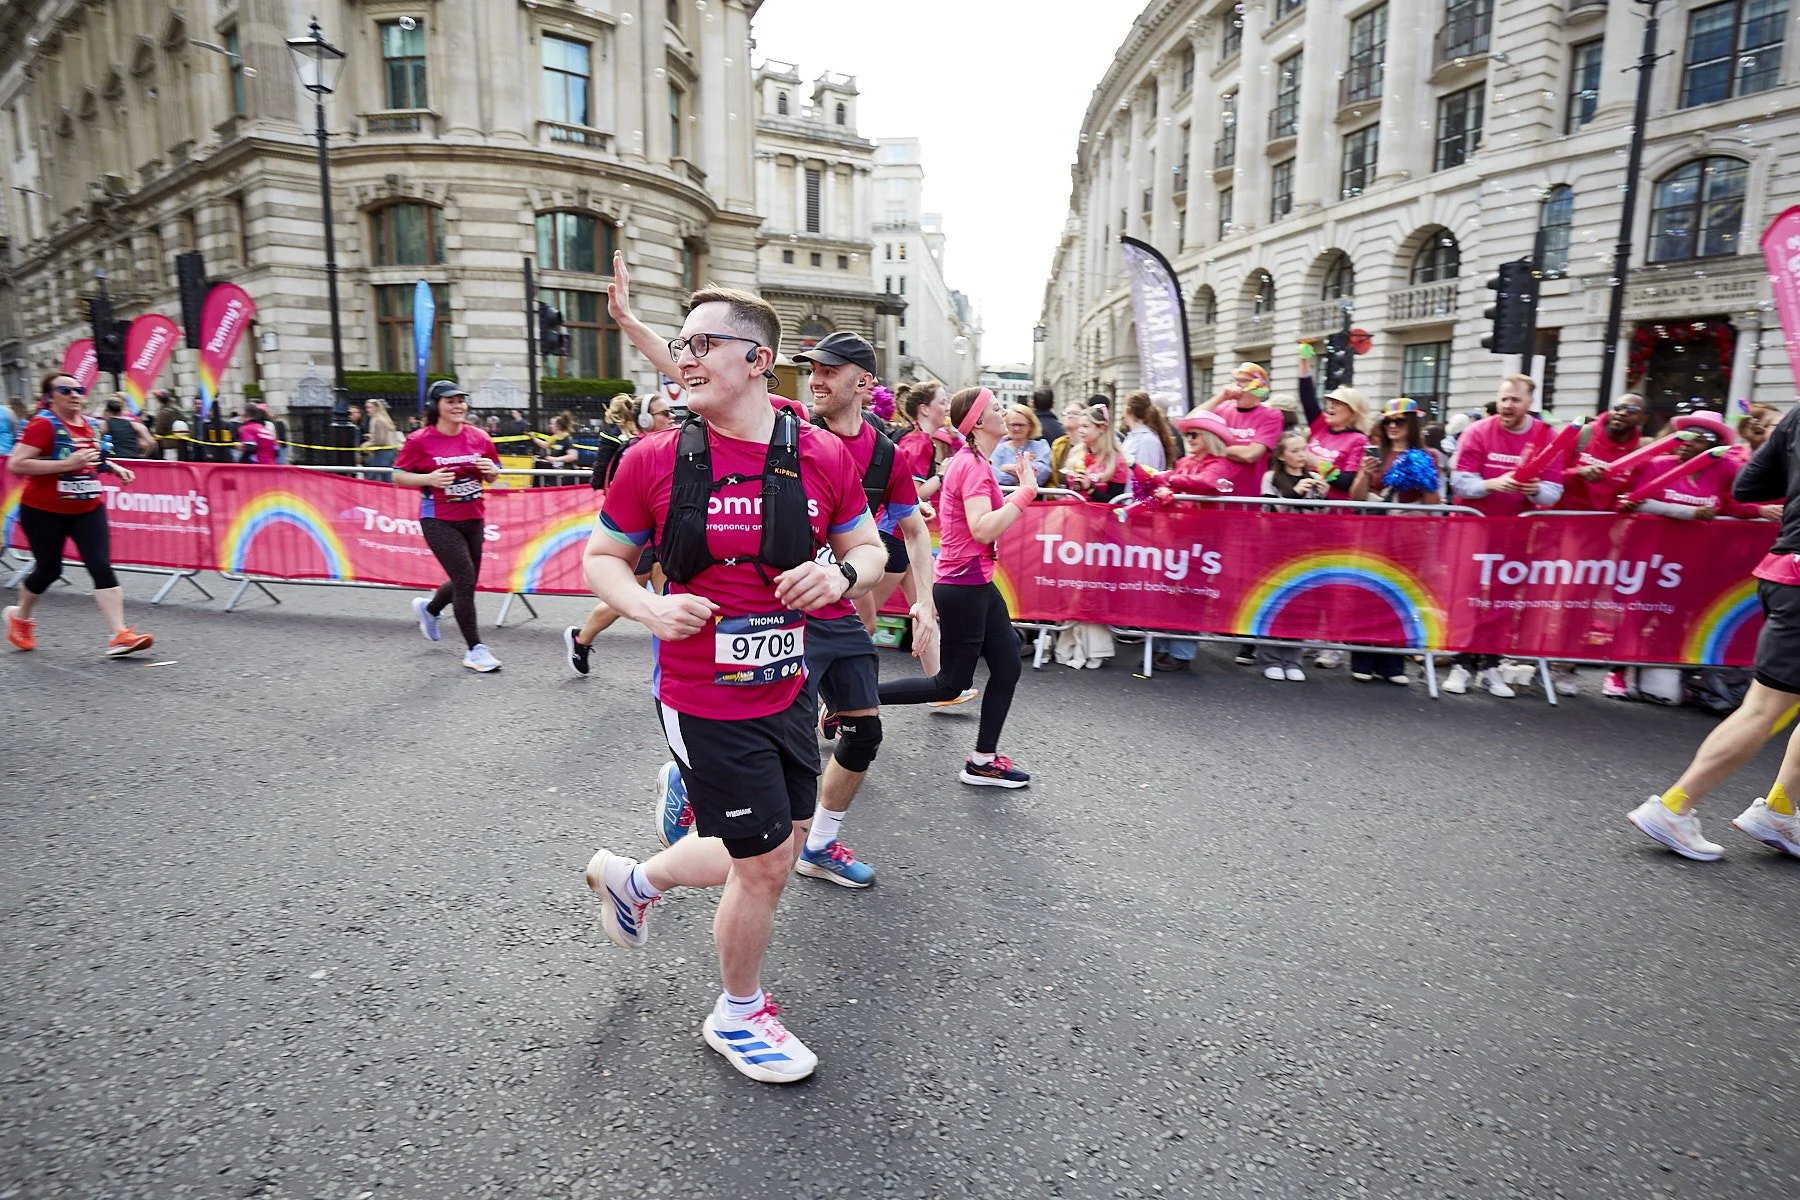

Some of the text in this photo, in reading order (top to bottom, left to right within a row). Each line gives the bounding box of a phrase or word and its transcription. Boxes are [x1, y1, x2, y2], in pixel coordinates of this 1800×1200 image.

[102, 485, 210, 520] Tommy's
[356, 506, 501, 541] Toms
[1035, 534, 1222, 580] Tommy's
[1034, 576, 1056, 586] The
[1057, 579, 1117, 592] pregnancy
[1118, 580, 1143, 590] and
[1144, 581, 1176, 595] baby
[1472, 553, 1684, 595] Tommy's
[749, 616, 784, 626] THOMAS
[1467, 597, 1491, 608] The
[1493, 600, 1561, 611] pregnancy
[1564, 599, 1590, 609] and
[1627, 601, 1675, 614] charity
[732, 631, 795, 660] 9709
